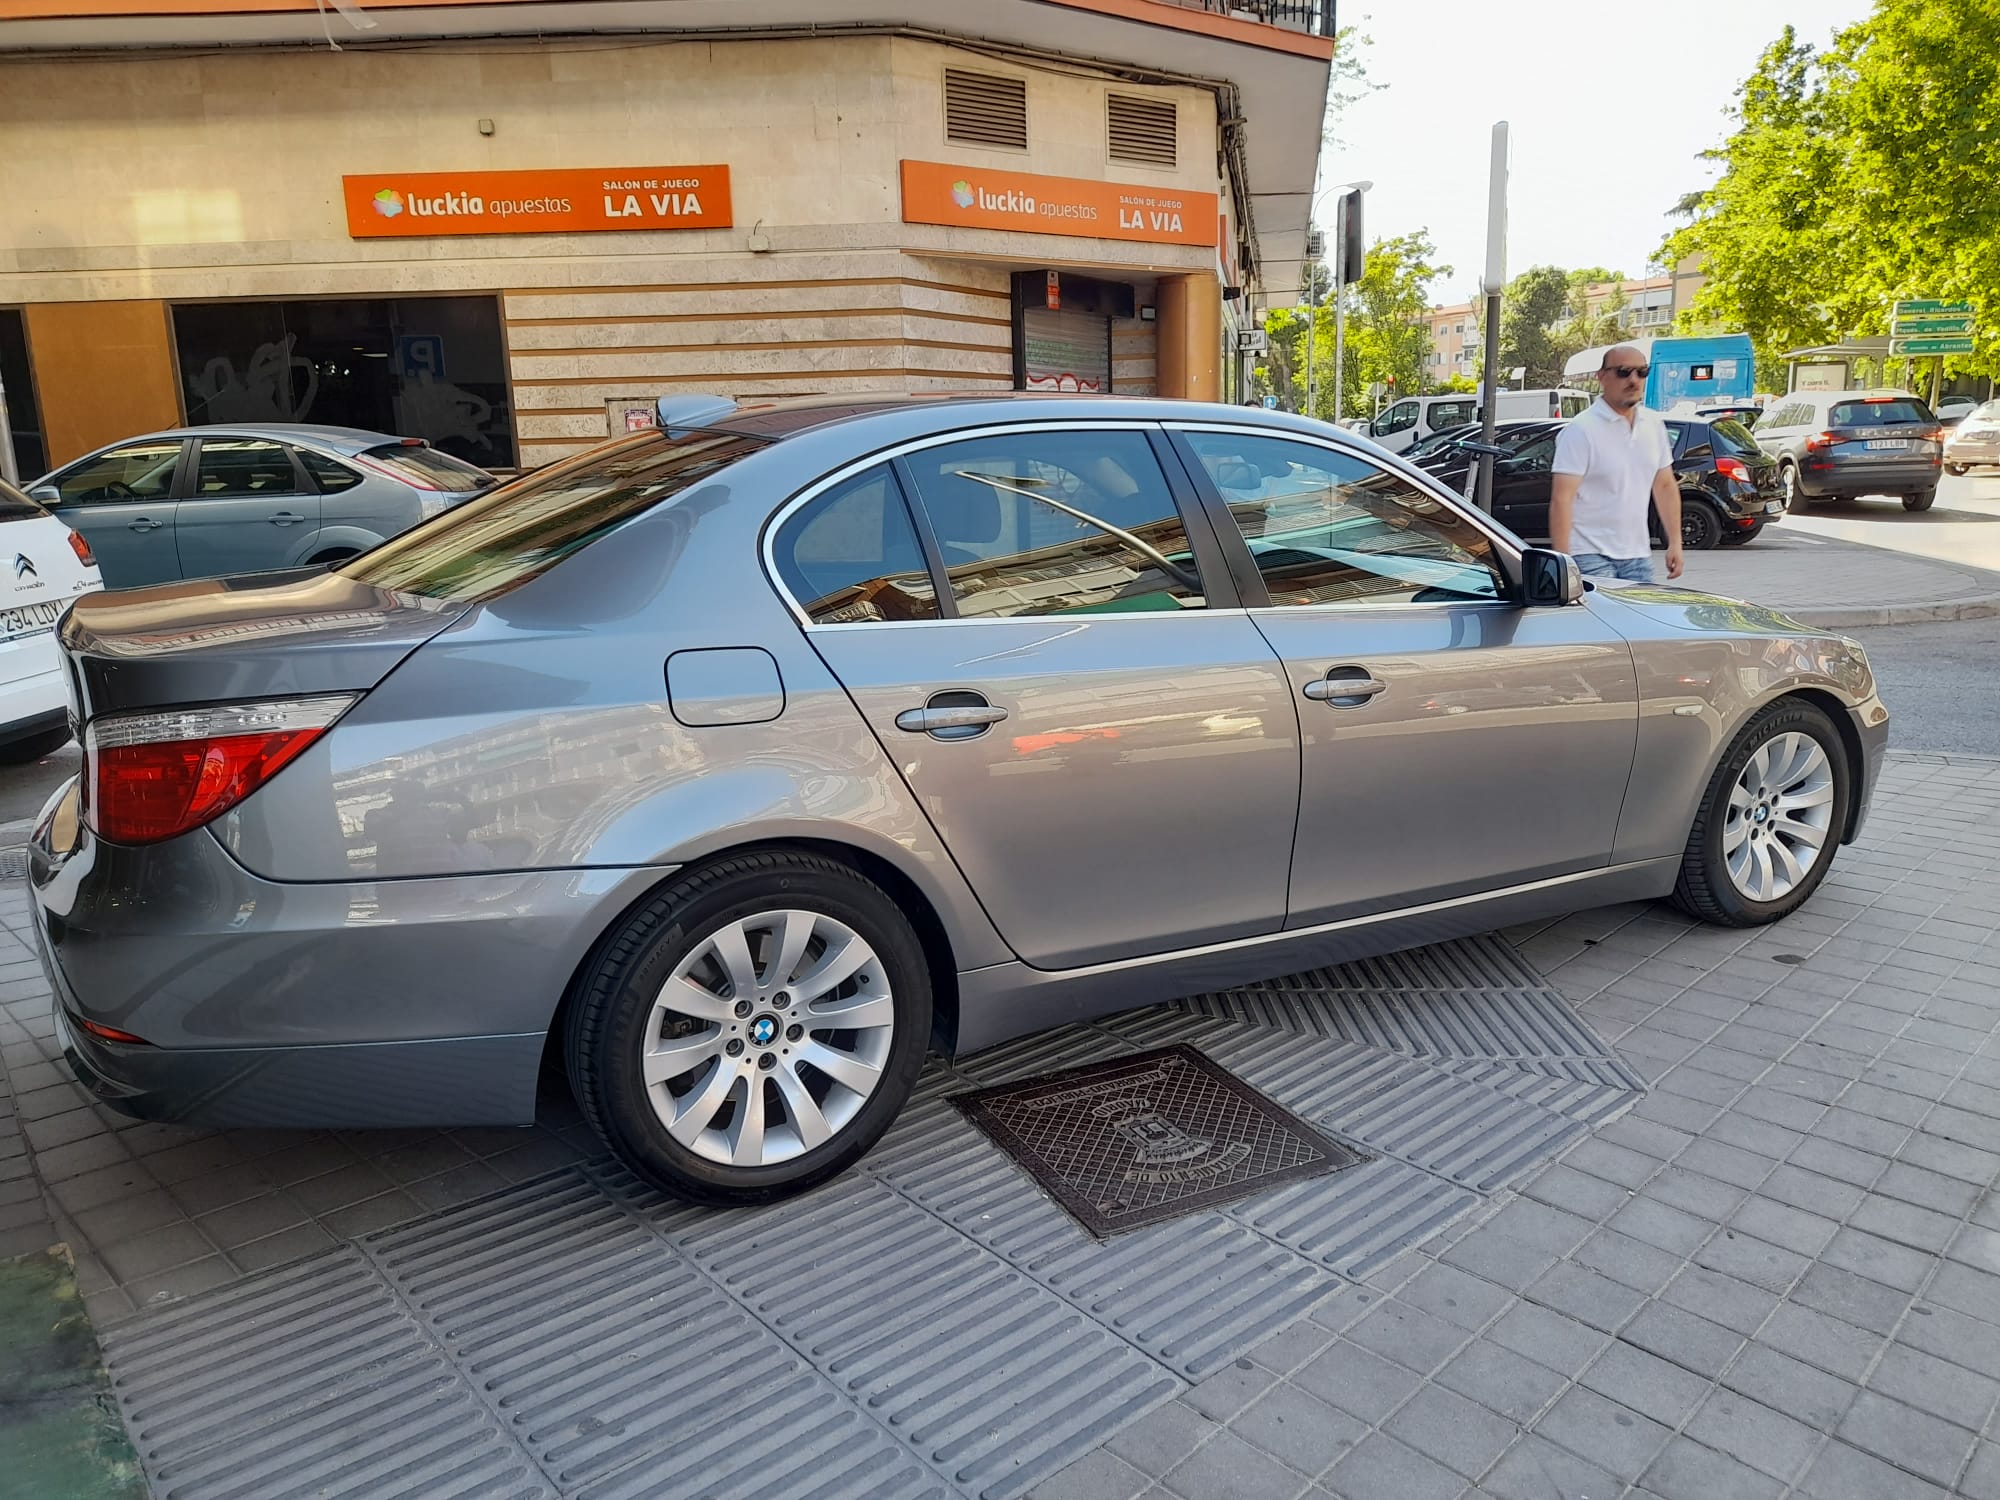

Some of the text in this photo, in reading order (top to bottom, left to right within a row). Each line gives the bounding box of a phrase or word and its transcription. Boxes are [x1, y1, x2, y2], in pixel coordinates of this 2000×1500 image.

[643, 179, 659, 189] DE
[661, 178, 700, 188] JUEGO
[407, 192, 572, 218] luckia apuestas
[604, 193, 703, 217] LA VIA
[978, 186, 1097, 221] luckia apuestas
[1146, 198, 1156, 207] DE
[1157, 199, 1183, 210] JUEGO
[1119, 208, 1184, 234] LA VIA
[31, 602, 59, 625] LDY
